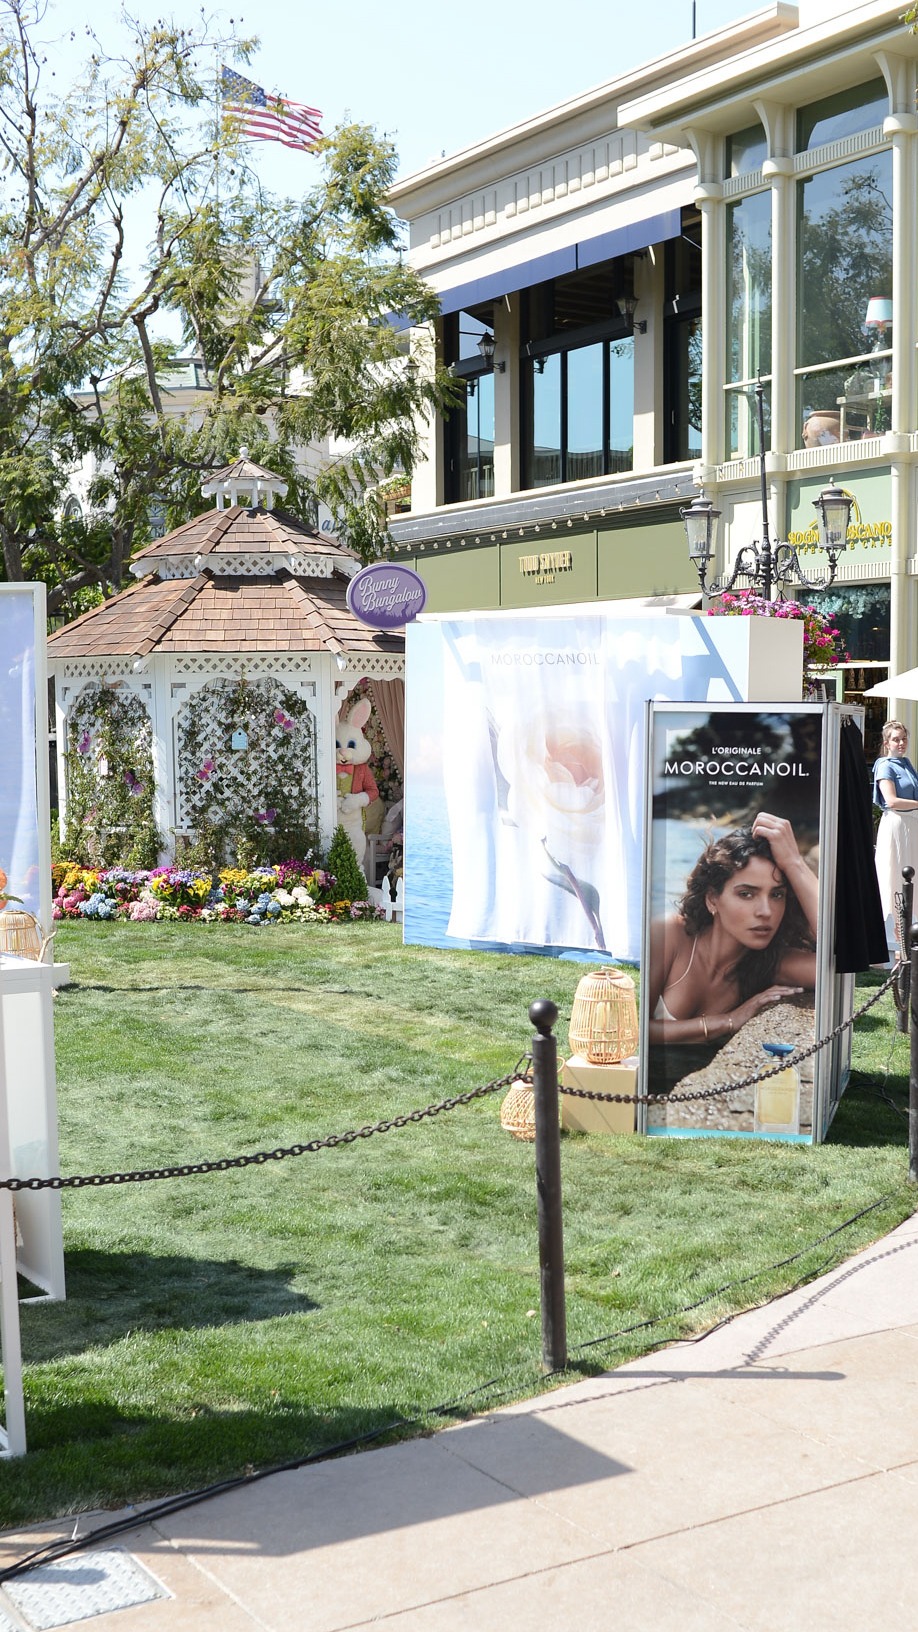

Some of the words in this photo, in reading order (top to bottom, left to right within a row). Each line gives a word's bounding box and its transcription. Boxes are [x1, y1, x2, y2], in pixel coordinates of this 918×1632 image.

[358, 575, 400, 596] Bunny
[362, 587, 422, 611] Bungalow
[491, 652, 600, 665] MOROCCANOIL
[711, 747, 762, 755] L'ORIGINALE
